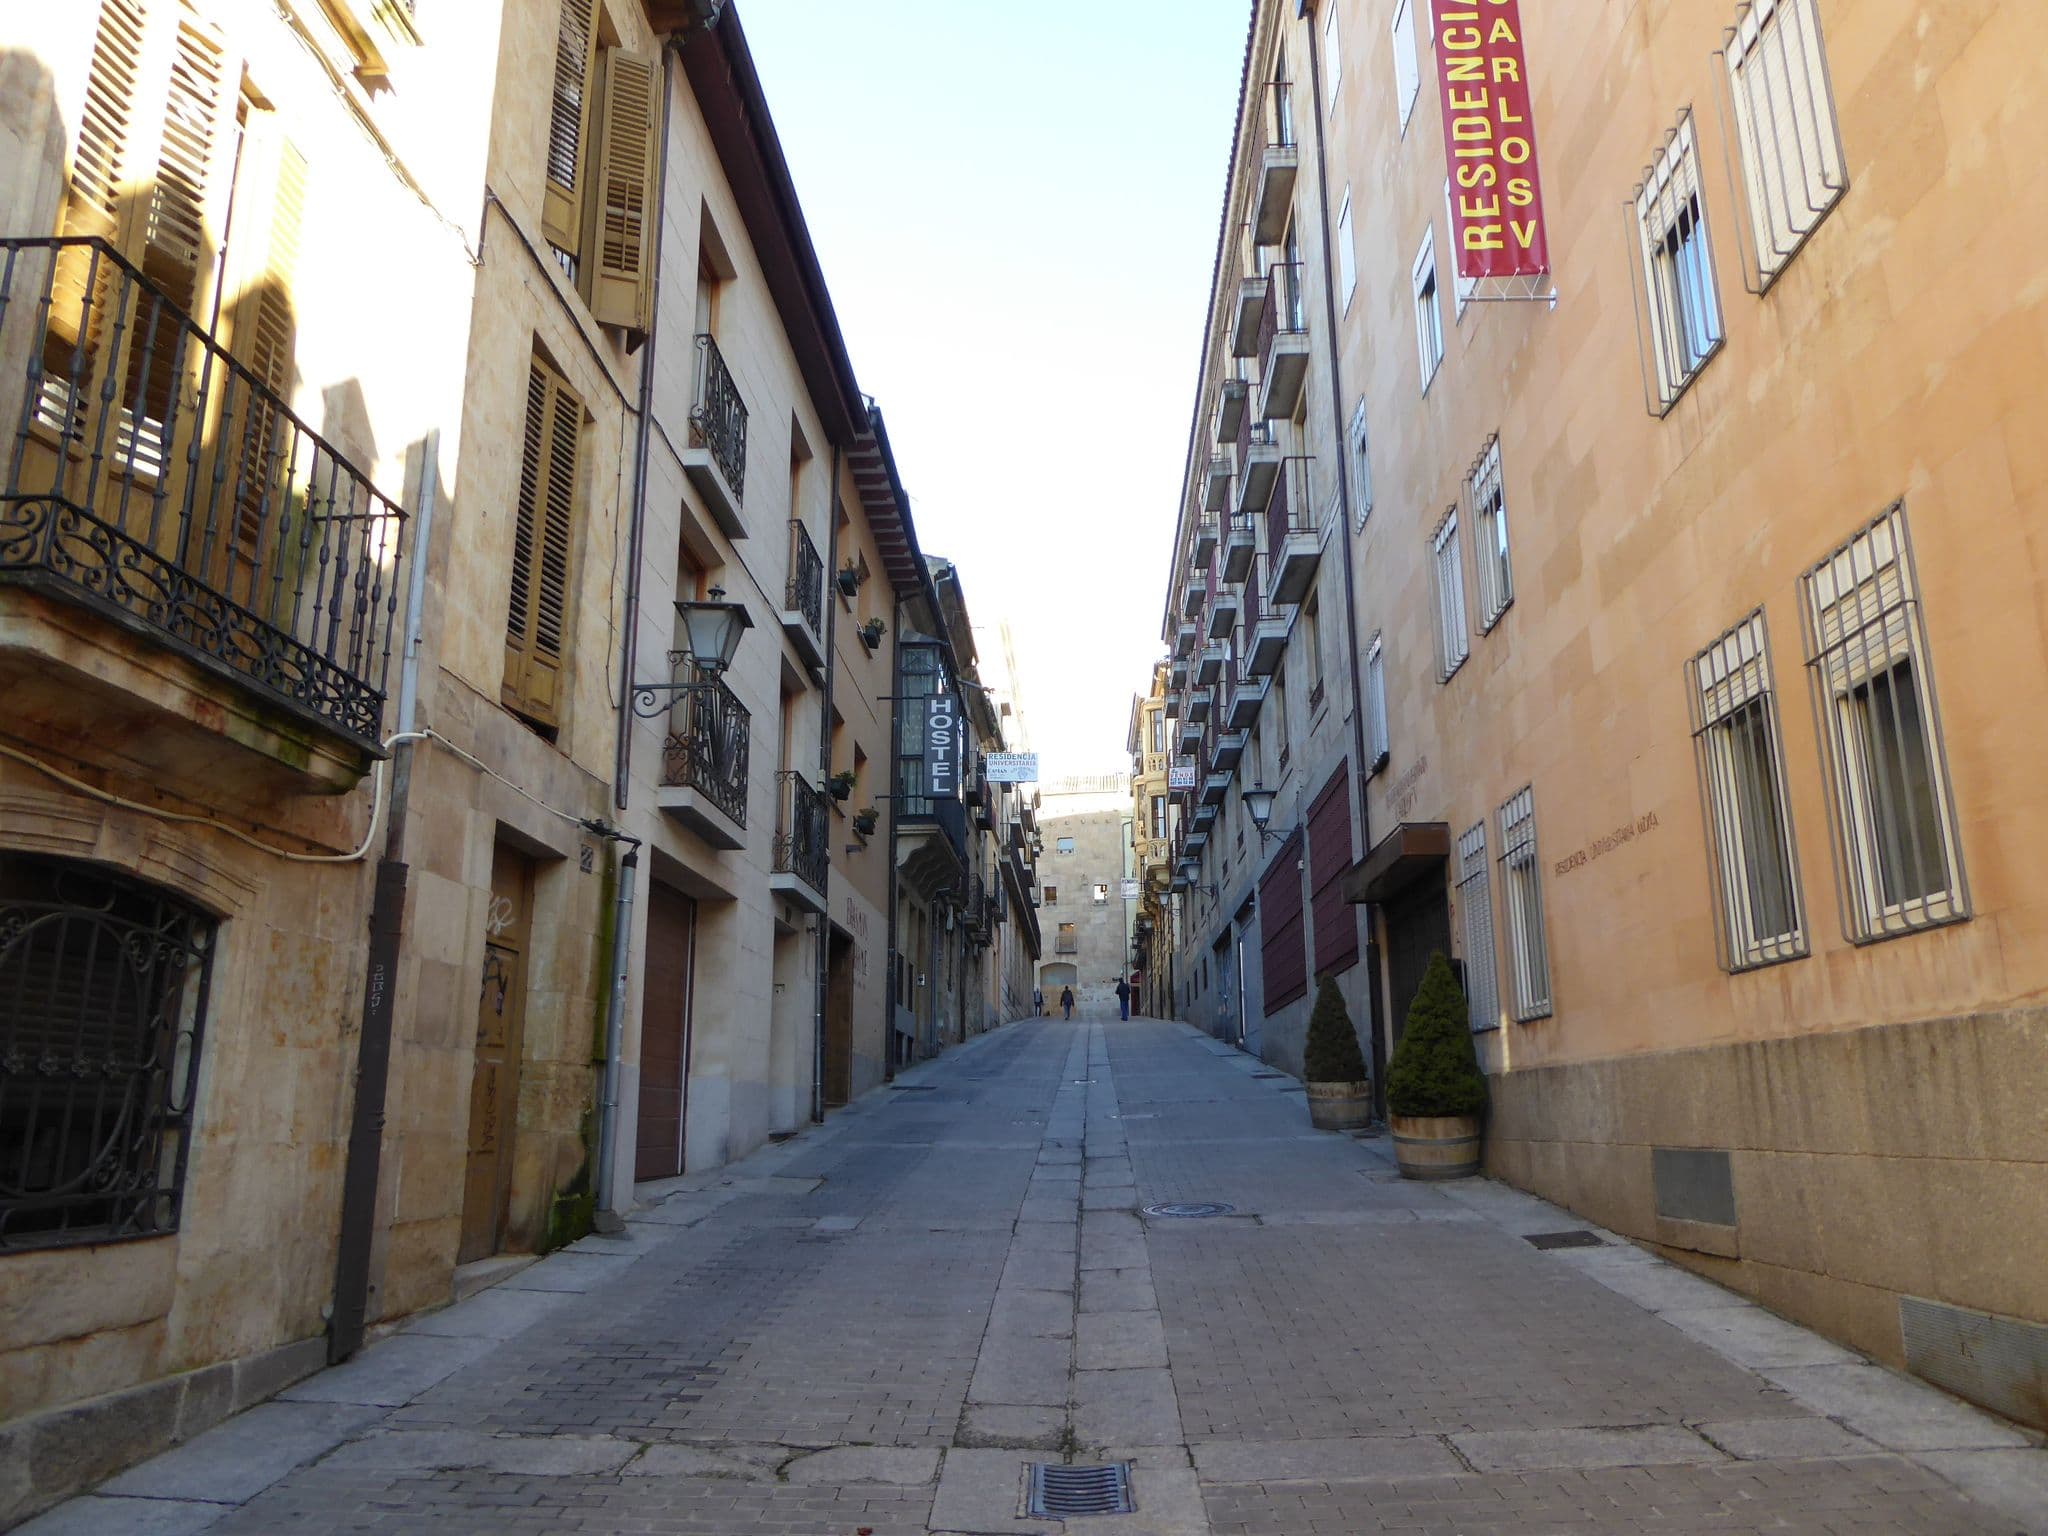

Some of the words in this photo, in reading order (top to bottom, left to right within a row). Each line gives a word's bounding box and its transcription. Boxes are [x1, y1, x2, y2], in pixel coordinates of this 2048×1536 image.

[1440, 0, 1504, 250] RESIDENCI
[1488, 0, 1534, 207] ARLOS
[1510, 220, 1536, 249] V
[929, 699, 953, 792] HOSTEL
